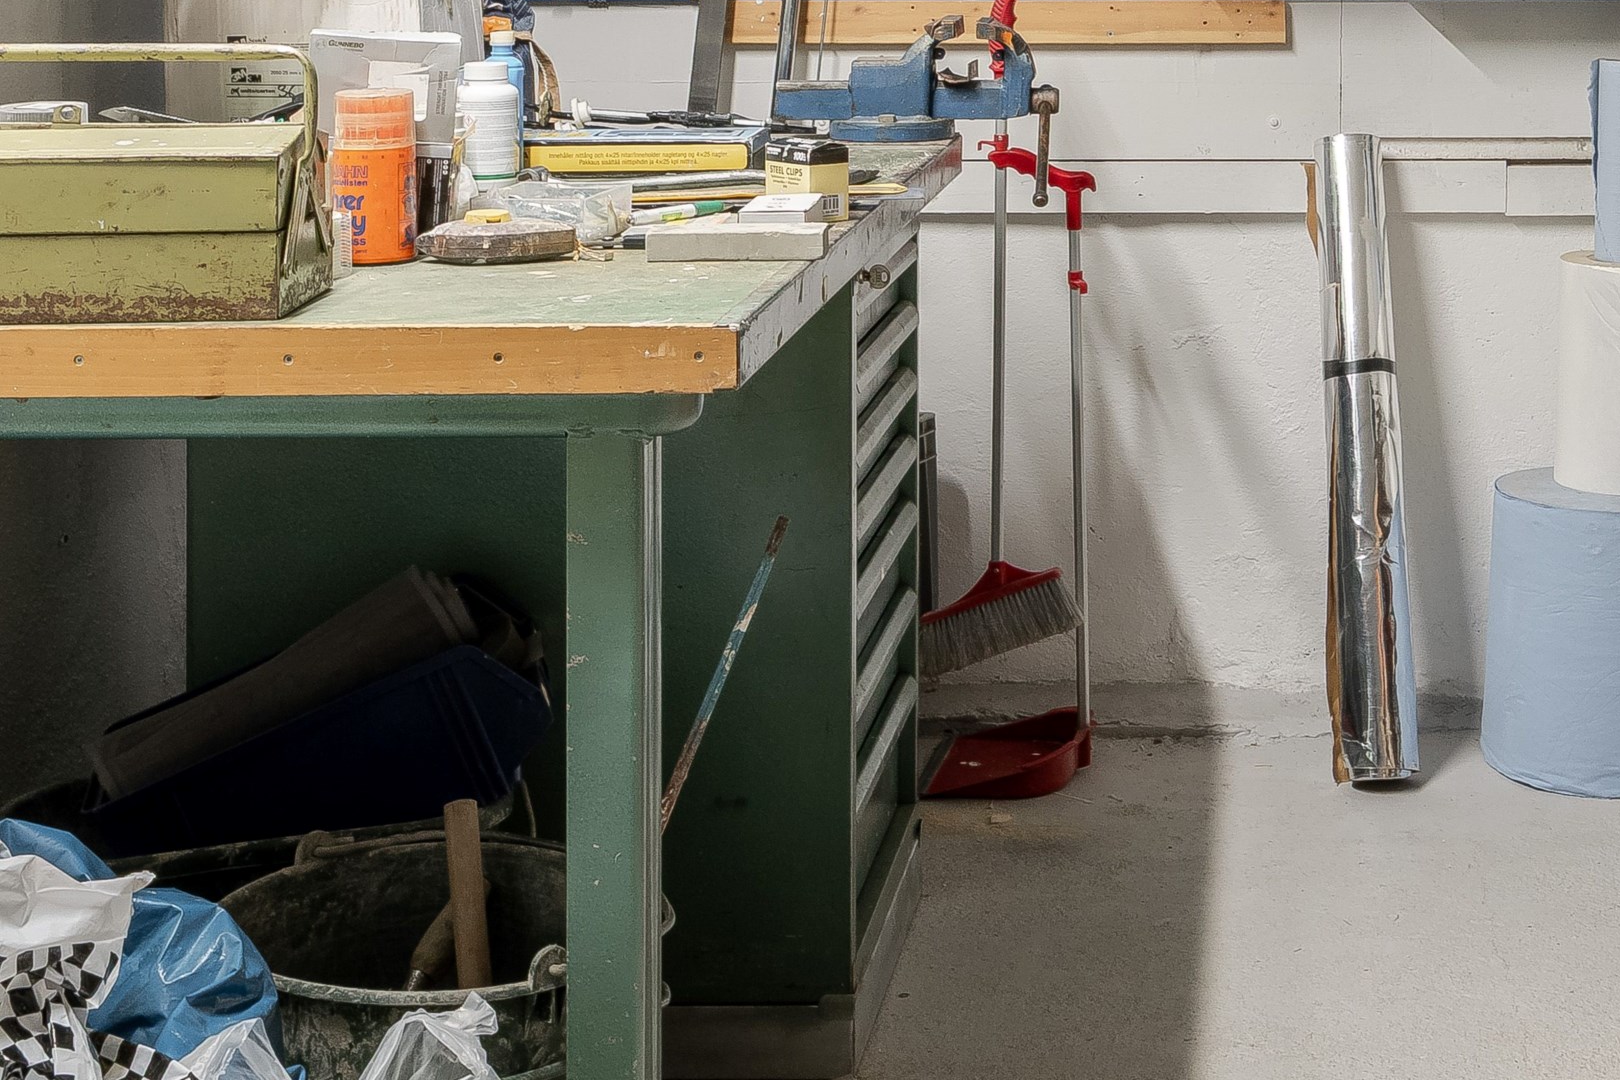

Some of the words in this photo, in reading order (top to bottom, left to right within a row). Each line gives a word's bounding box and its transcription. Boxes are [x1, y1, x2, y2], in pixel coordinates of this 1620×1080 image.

[247, 74, 262, 83] 3M
[769, 164, 785, 175] STEEL
[785, 167, 803, 177] CLIPS
